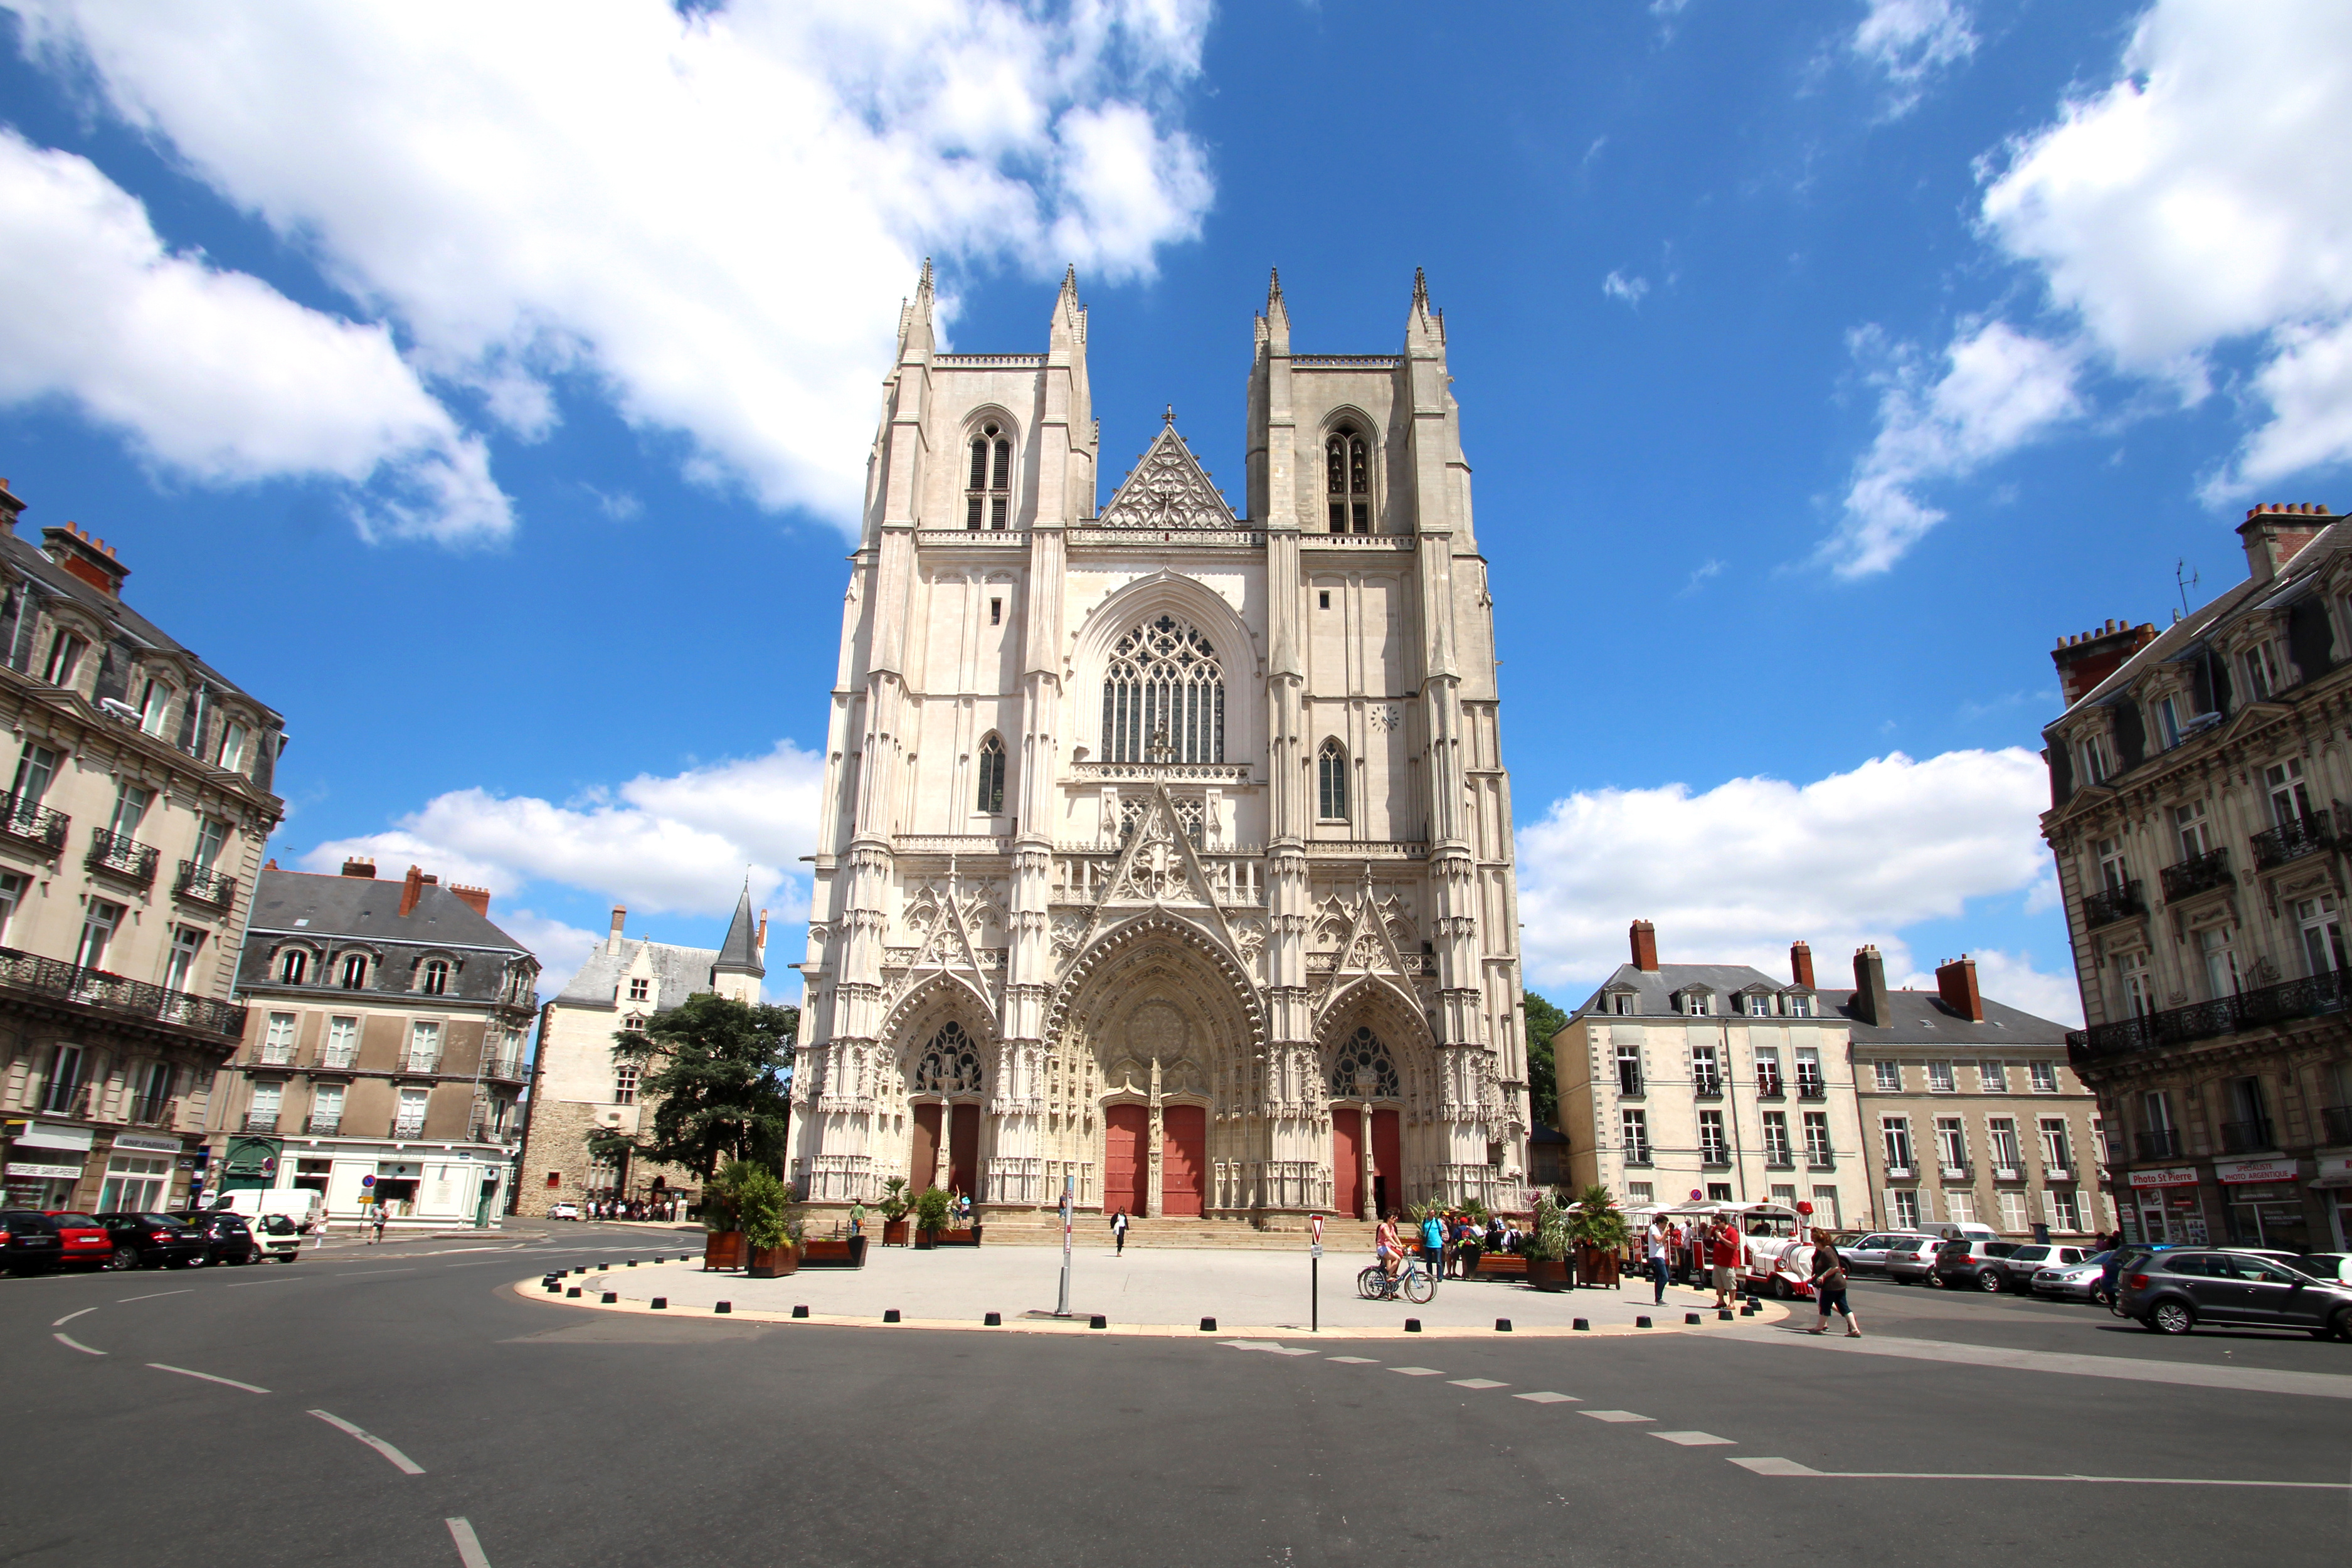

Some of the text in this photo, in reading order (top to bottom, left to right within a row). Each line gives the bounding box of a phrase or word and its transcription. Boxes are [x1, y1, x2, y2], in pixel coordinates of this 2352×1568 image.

[123, 1138, 176, 1150] BNP PARIBAS
[2133, 1172, 2192, 1184] Photo St Pierre
[2225, 1170, 2289, 1181] PHOTO ARGENTIQUE
